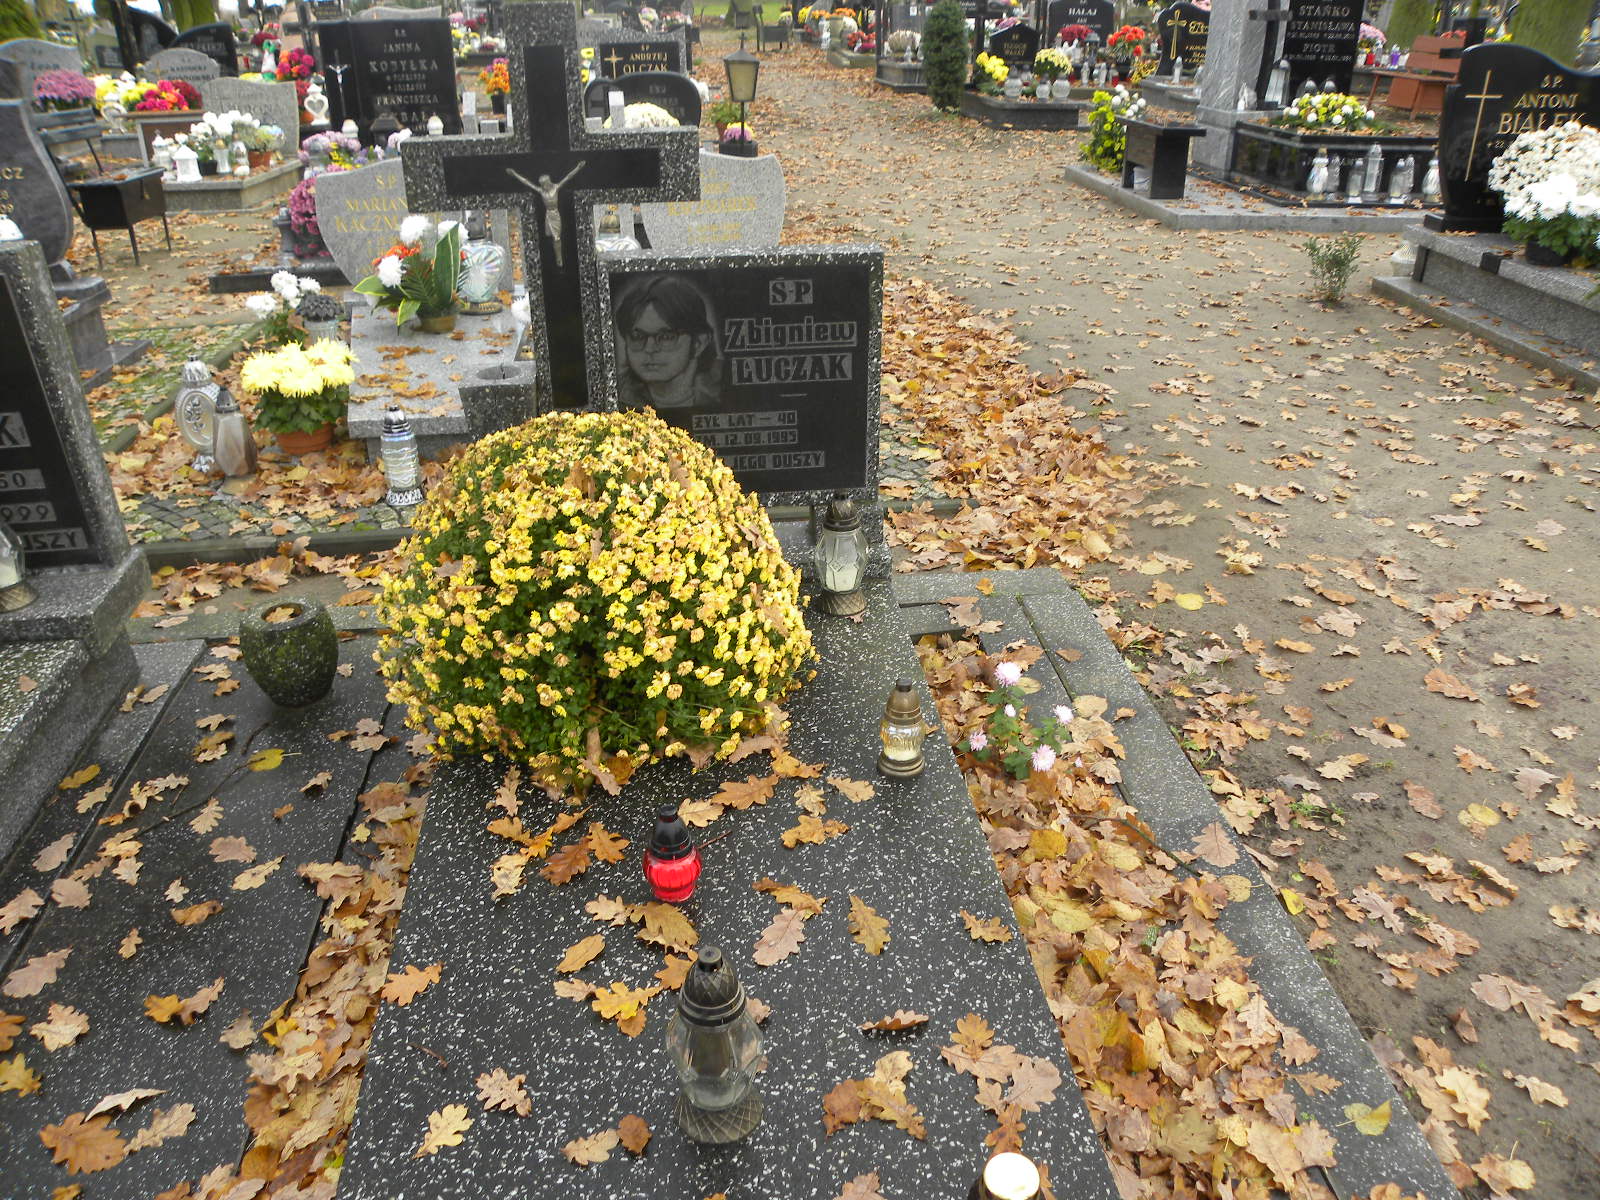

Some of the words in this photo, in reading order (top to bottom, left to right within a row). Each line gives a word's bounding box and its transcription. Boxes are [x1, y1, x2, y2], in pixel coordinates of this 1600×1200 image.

[1513, 92, 1580, 109] ANTONI
[724, 316, 857, 351] Zbigniew
[727, 412, 754, 427] LAT
[771, 451, 824, 469] DUSZY
